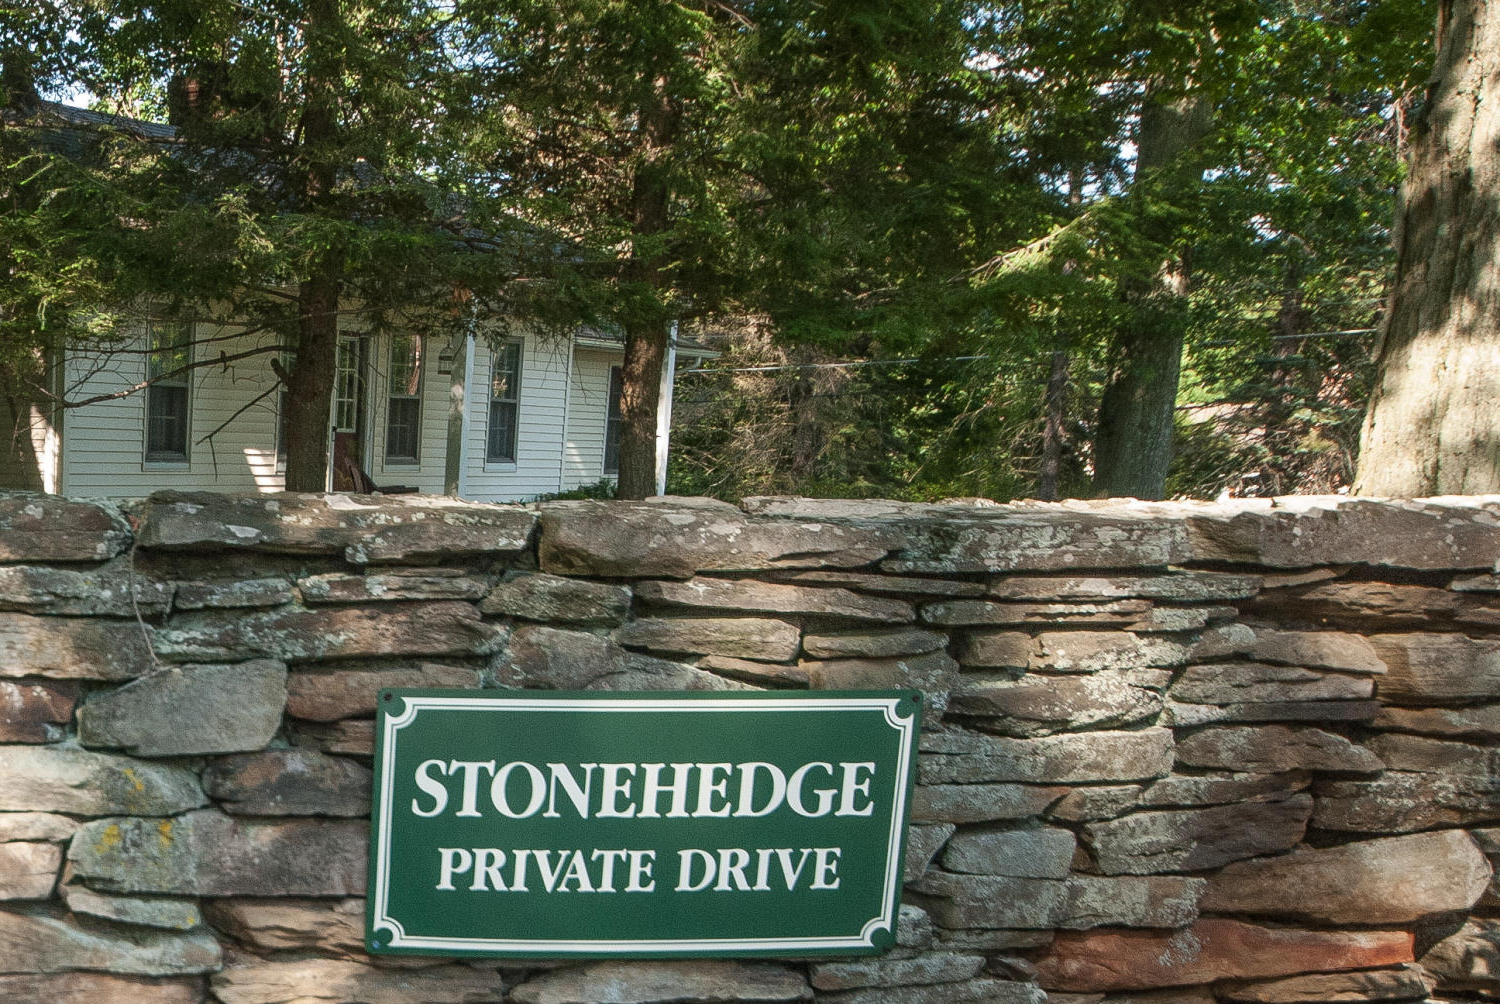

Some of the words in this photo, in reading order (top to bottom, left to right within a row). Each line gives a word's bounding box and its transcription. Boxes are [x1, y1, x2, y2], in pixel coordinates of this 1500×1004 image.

[411, 759, 876, 819] STONEHEDGE
[435, 847, 656, 893] PRIVATE
[674, 847, 841, 892] DRIVE
